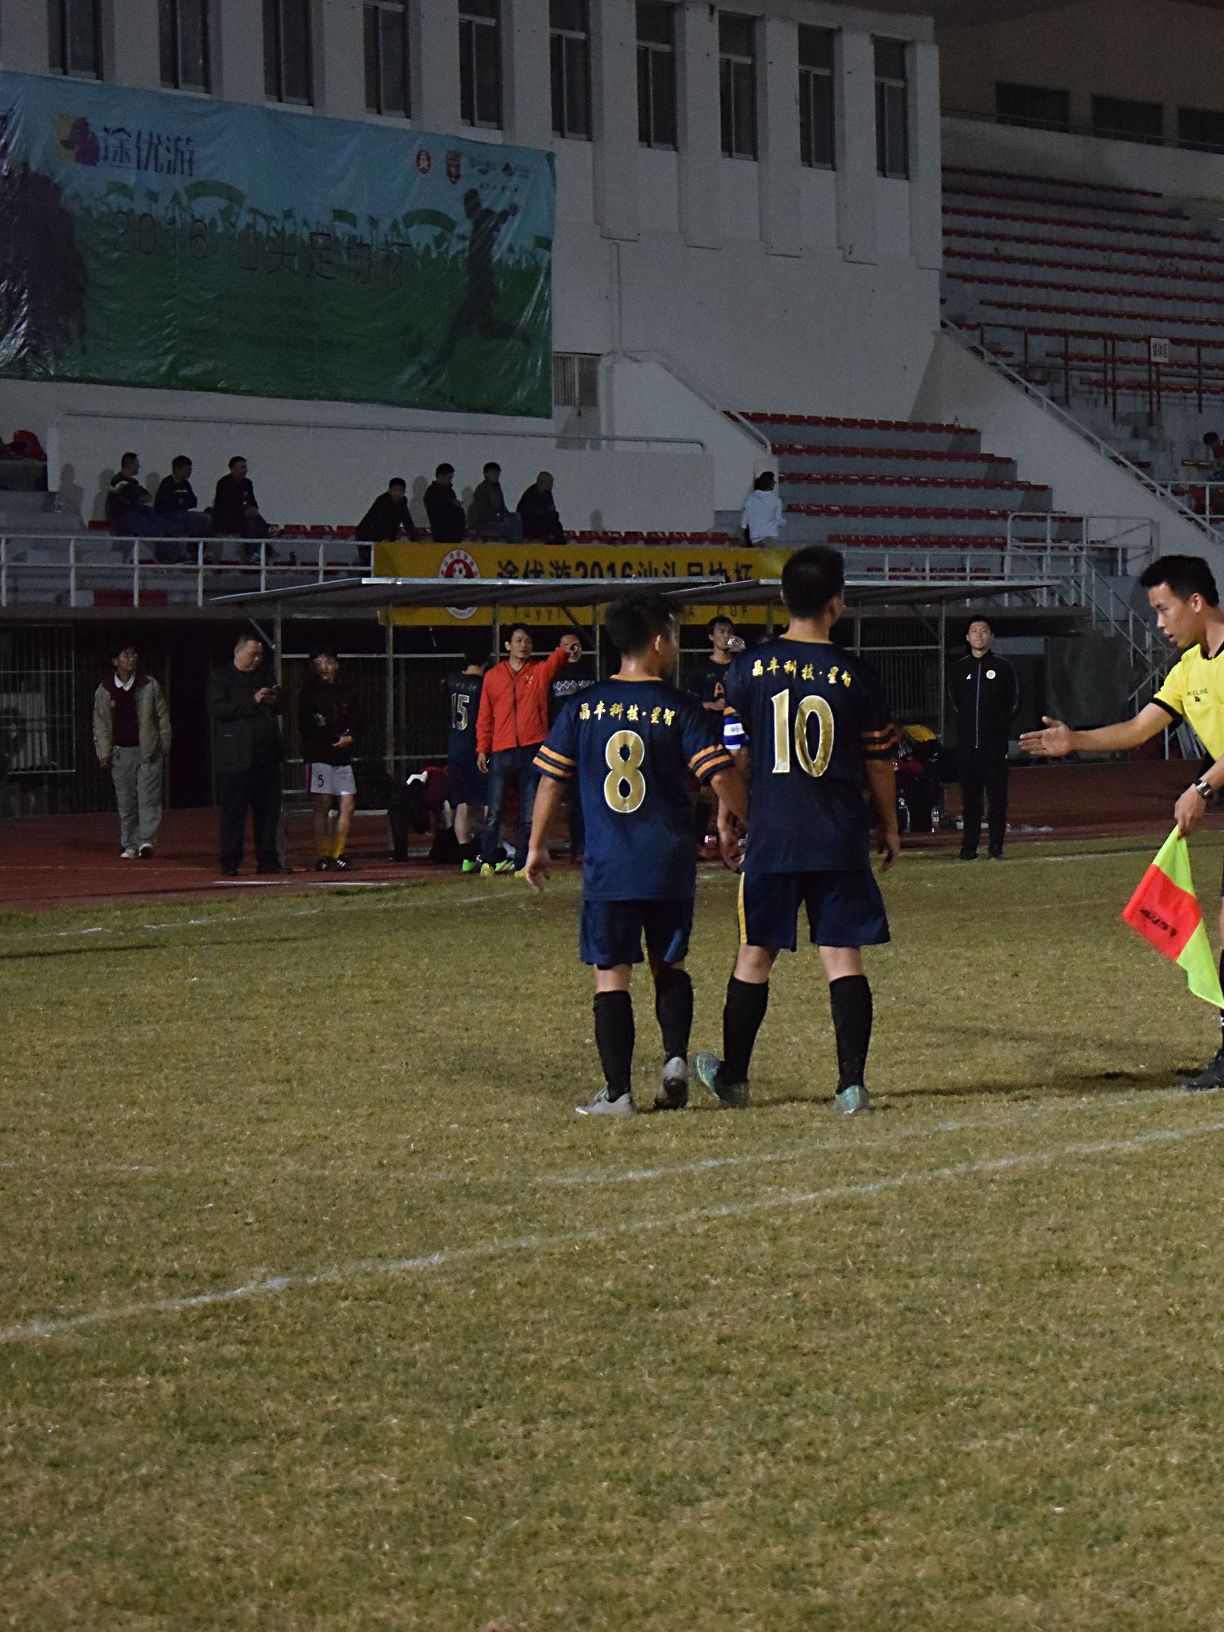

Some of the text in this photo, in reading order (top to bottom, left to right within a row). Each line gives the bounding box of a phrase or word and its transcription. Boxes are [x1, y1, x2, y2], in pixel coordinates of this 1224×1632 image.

[102, 127, 194, 176] 途优游
[451, 692, 471, 732] 15
[771, 688, 835, 778] 10
[318, 774, 325, 787] 5
[603, 729, 647, 814] 8
